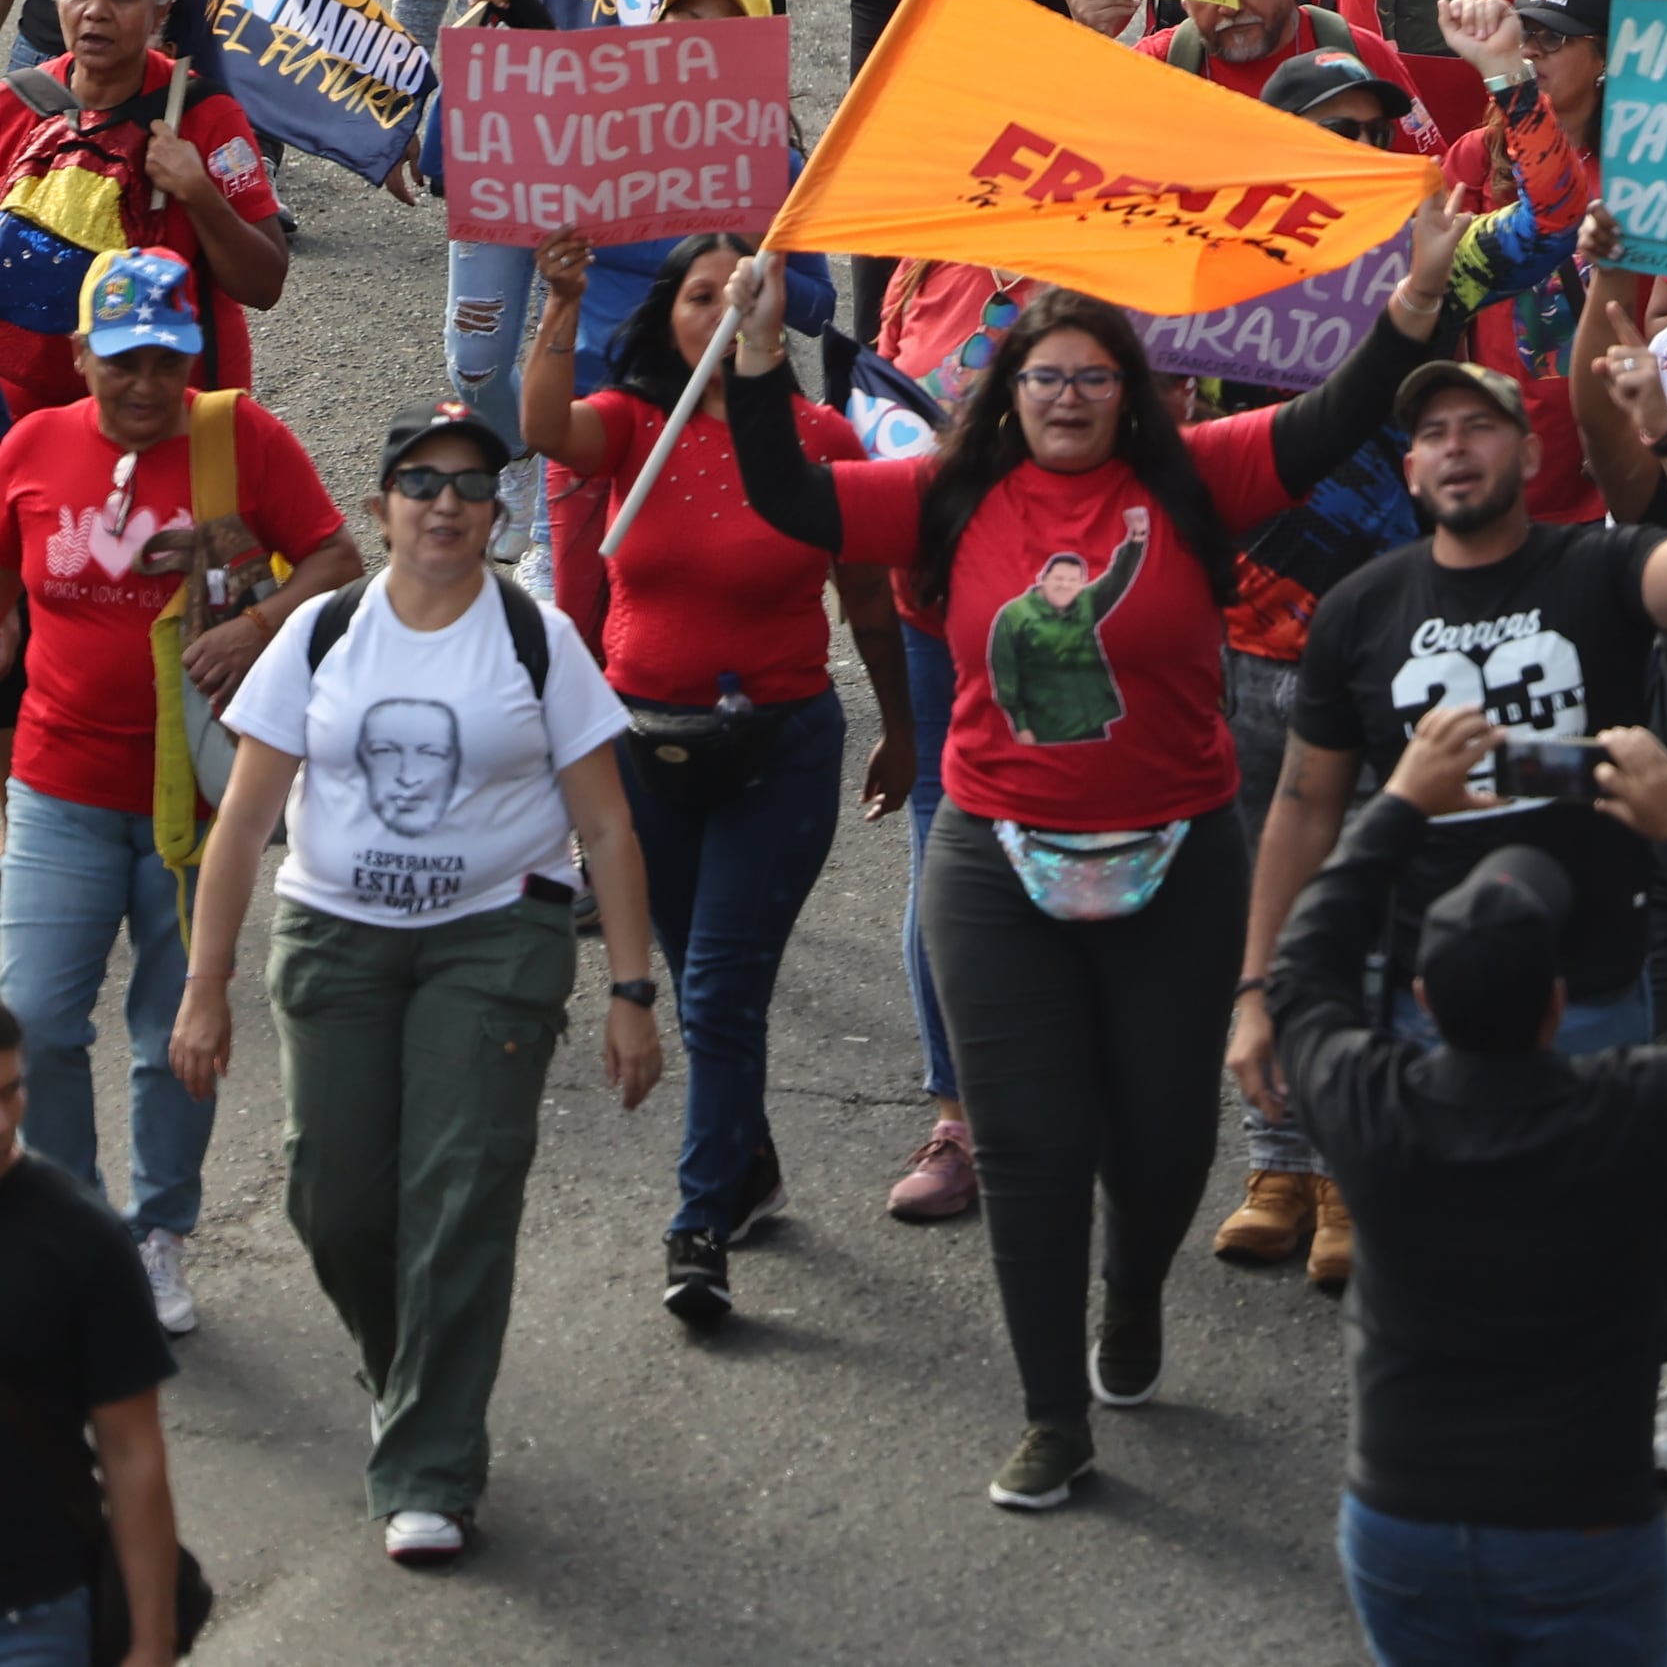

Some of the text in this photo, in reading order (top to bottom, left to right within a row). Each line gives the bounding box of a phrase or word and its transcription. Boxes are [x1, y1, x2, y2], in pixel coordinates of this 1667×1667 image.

[466, 35, 720, 102] ¡HASTA
[449, 97, 790, 168] LA VICTORIA
[469, 154, 753, 231] SIEMPRE!
[970, 122, 1345, 248] FRENTE
[1256, 365, 1281, 381] DE
[1410, 607, 1543, 659] Caracas
[1391, 630, 1588, 796] 23
[352, 867, 460, 896] ESTÁ EN
[364, 850, 466, 873] ESPERANZA
